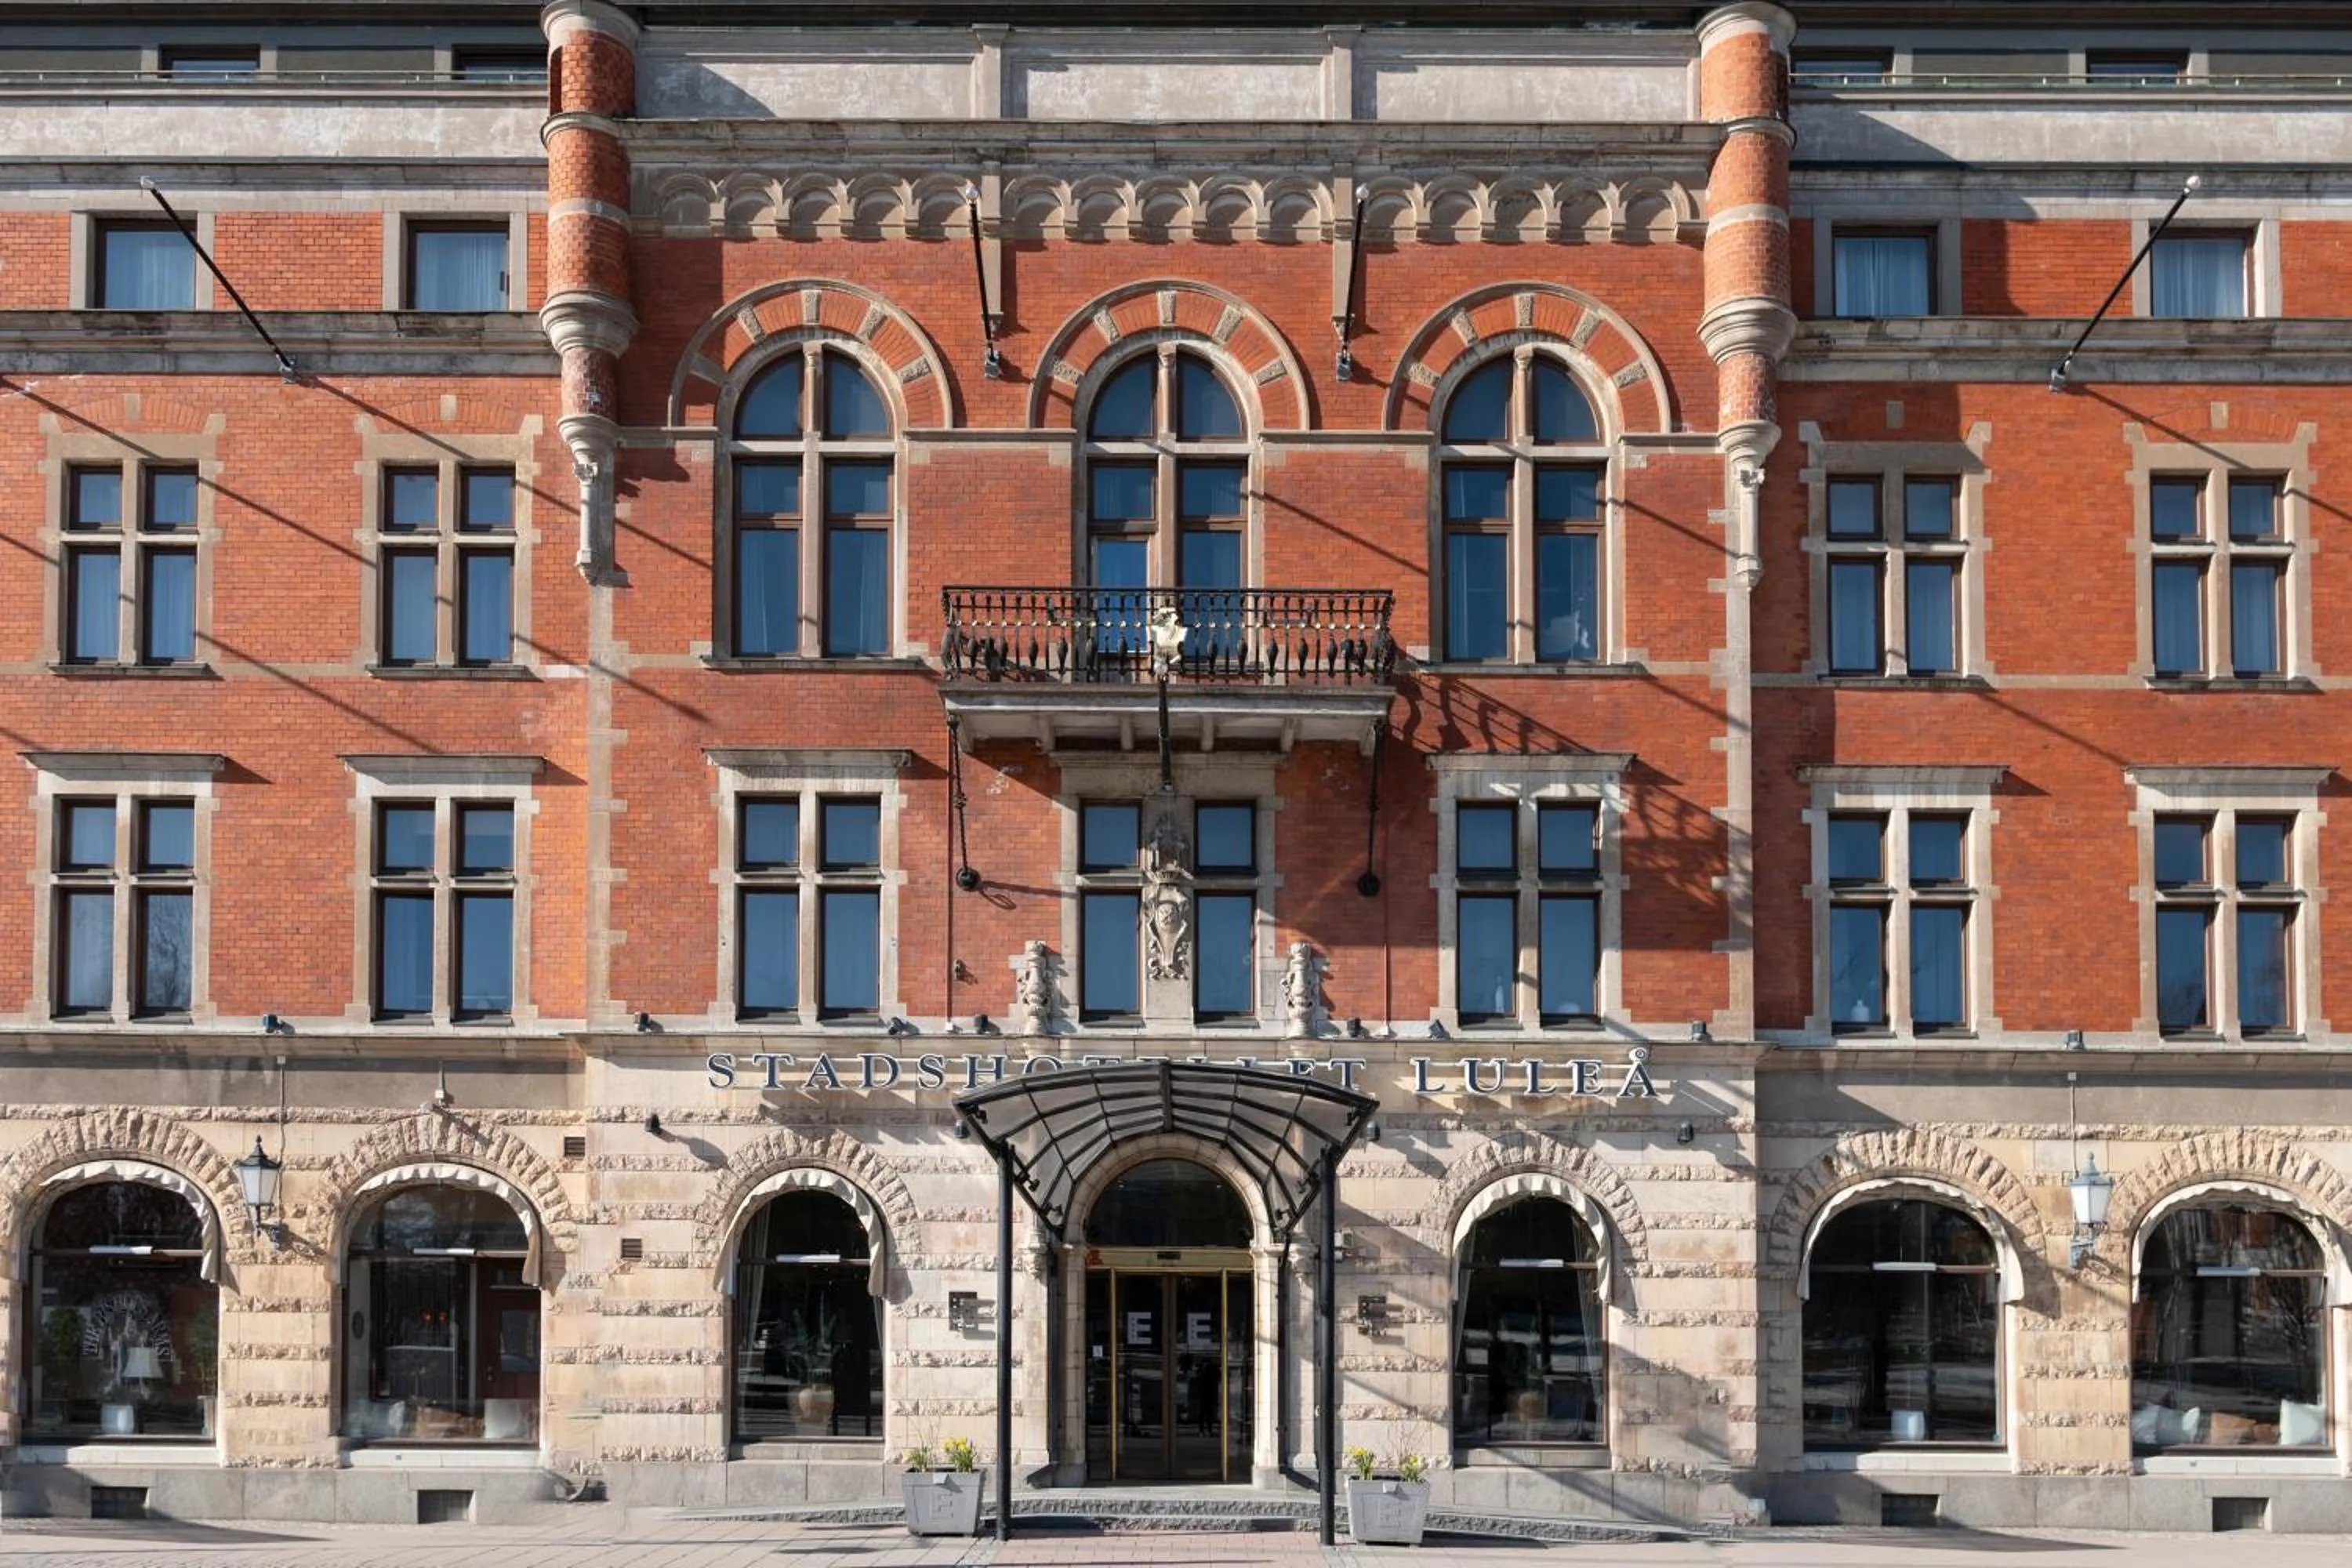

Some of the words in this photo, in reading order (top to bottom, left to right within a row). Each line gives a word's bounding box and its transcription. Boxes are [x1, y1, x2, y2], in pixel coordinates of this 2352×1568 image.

[706, 1053, 1367, 1091] STADSHOET
[1411, 1047, 1658, 1098] LULEÅ
[1127, 1312, 1152, 1345] E
[1187, 1312, 1211, 1345] E
